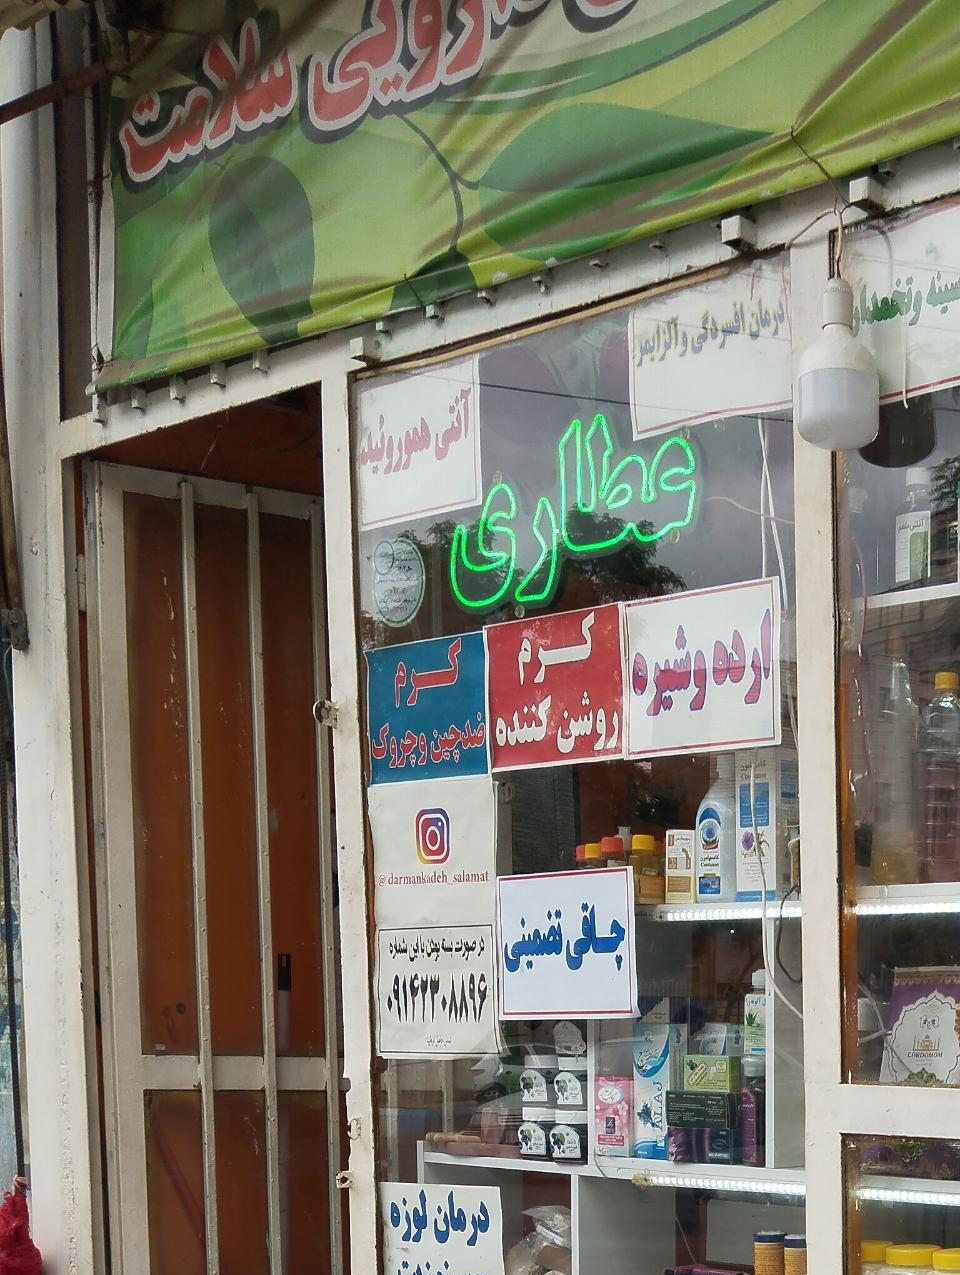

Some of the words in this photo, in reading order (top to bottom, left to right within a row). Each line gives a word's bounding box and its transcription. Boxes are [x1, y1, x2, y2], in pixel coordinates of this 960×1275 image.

[119, 18, 298, 184] سلامت
[692, 301, 746, 354] افسردگی
[750, 297, 785, 341] درمان
[434, 387, 472, 461] آنتی
[450, 413, 697, 609] عطاری
[394, 639, 462, 706] کرم
[518, 612, 595, 685] کرم
[712, 607, 771, 704] ارده
[496, 696, 552, 747] کننده
[556, 692, 620, 754] روشن
[454, 937, 477, 960] صورت
[503, 909, 563, 972] تضمینی
[565, 902, 626, 972] چاقی
[390, 1189, 428, 1242] لوزه
[433, 1190, 490, 1247] درمان
